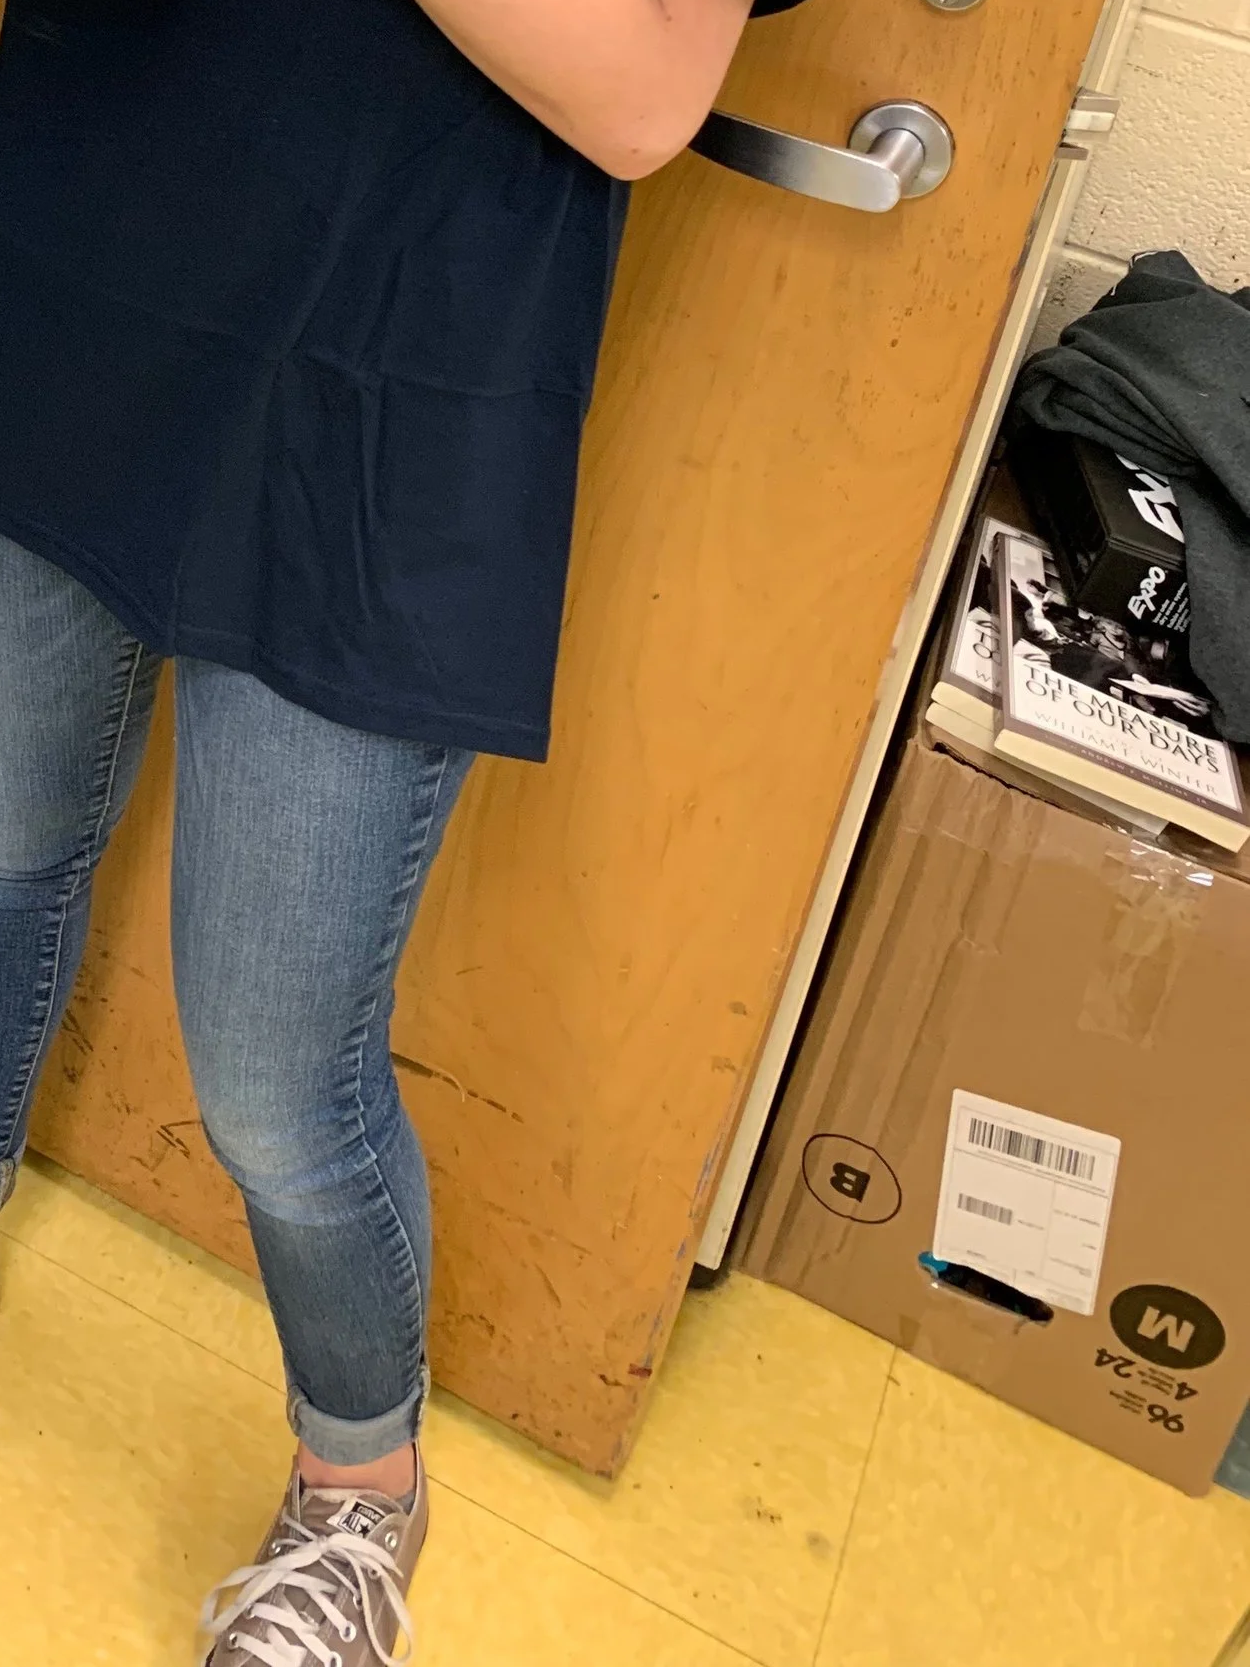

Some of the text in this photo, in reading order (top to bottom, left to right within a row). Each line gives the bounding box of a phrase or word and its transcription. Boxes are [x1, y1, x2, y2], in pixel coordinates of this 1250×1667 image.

[1127, 565, 1166, 620] EXPO
[1024, 663, 1080, 699] THE
[1090, 694, 1218, 759] MEASURE
[1025, 679, 1062, 703] OF
[1072, 700, 1141, 740] OUR
[1150, 732, 1220, 775] DAYS
[830, 1162, 871, 1203] B
[1136, 1305, 1196, 1354] M
[1094, 1348, 1137, 1379] 24
[1174, 1381, 1199, 1401] 4
[1146, 1403, 1185, 1433] 96
